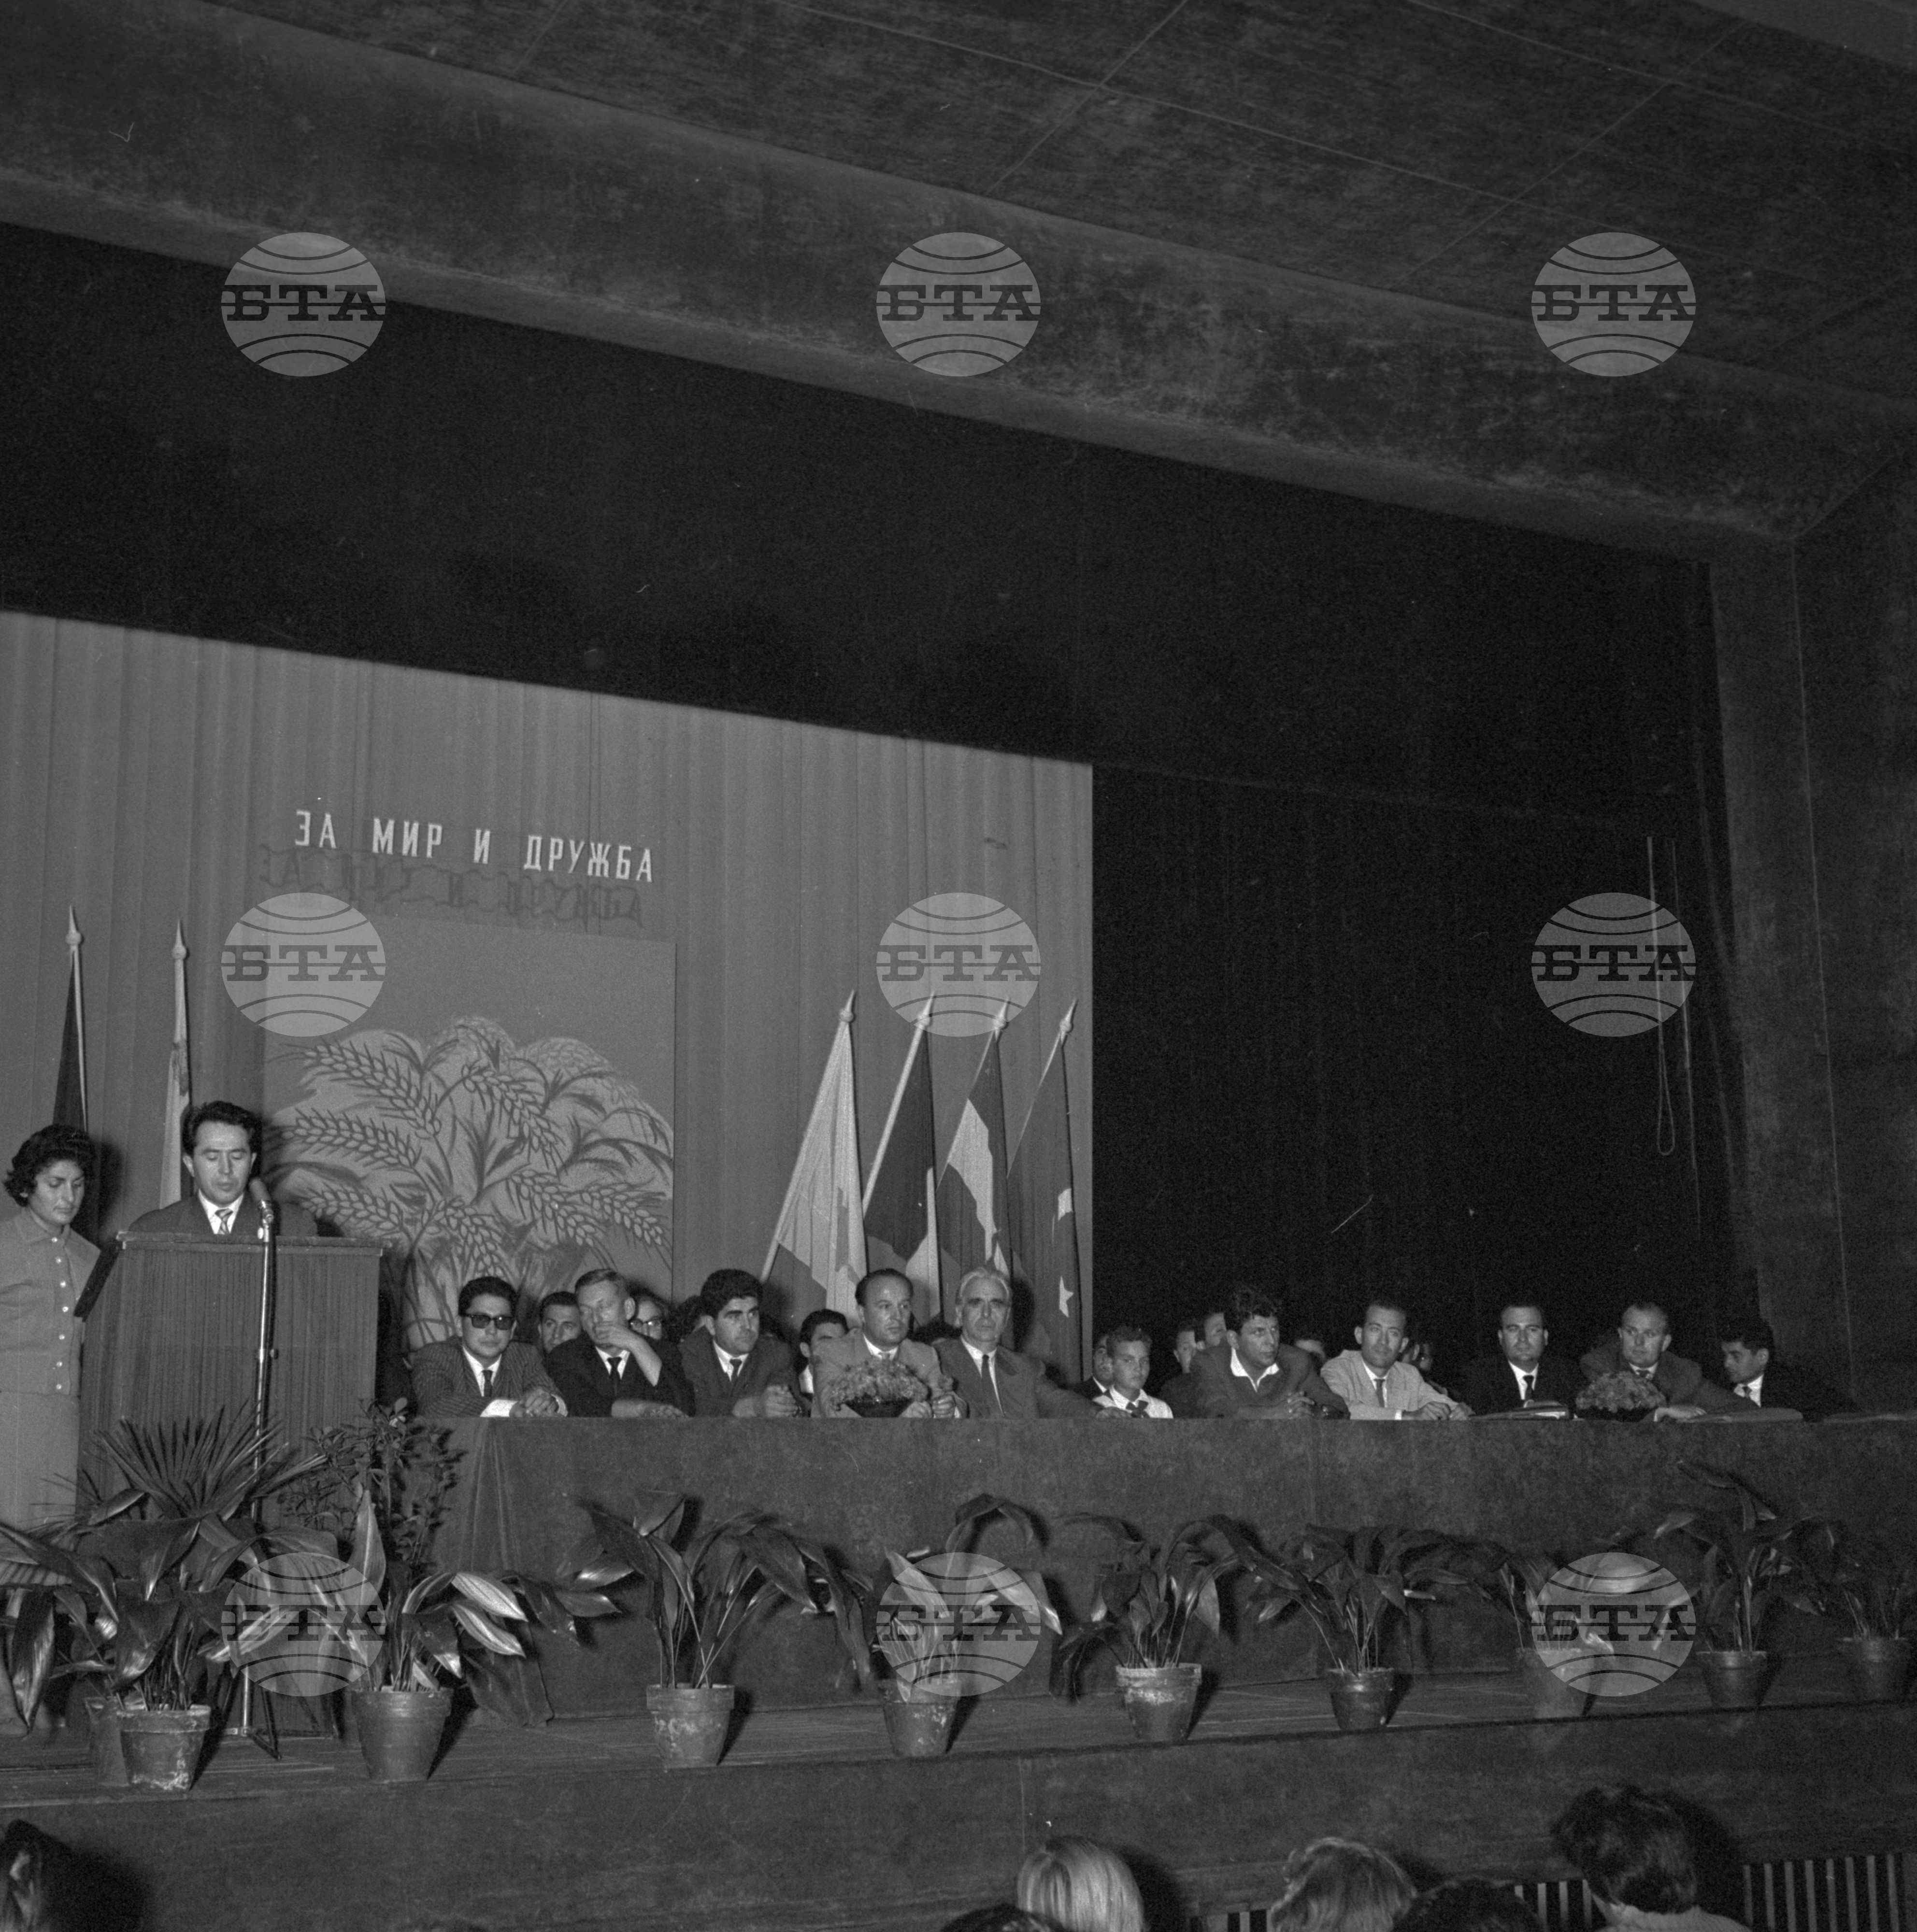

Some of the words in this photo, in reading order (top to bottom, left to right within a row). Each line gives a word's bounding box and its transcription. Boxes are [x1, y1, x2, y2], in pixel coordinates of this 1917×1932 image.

[295, 810, 337, 849] ЗА
[372, 818, 443, 858] МИР
[473, 828, 491, 865] И
[523, 834, 653, 883] ДРУЖБА
